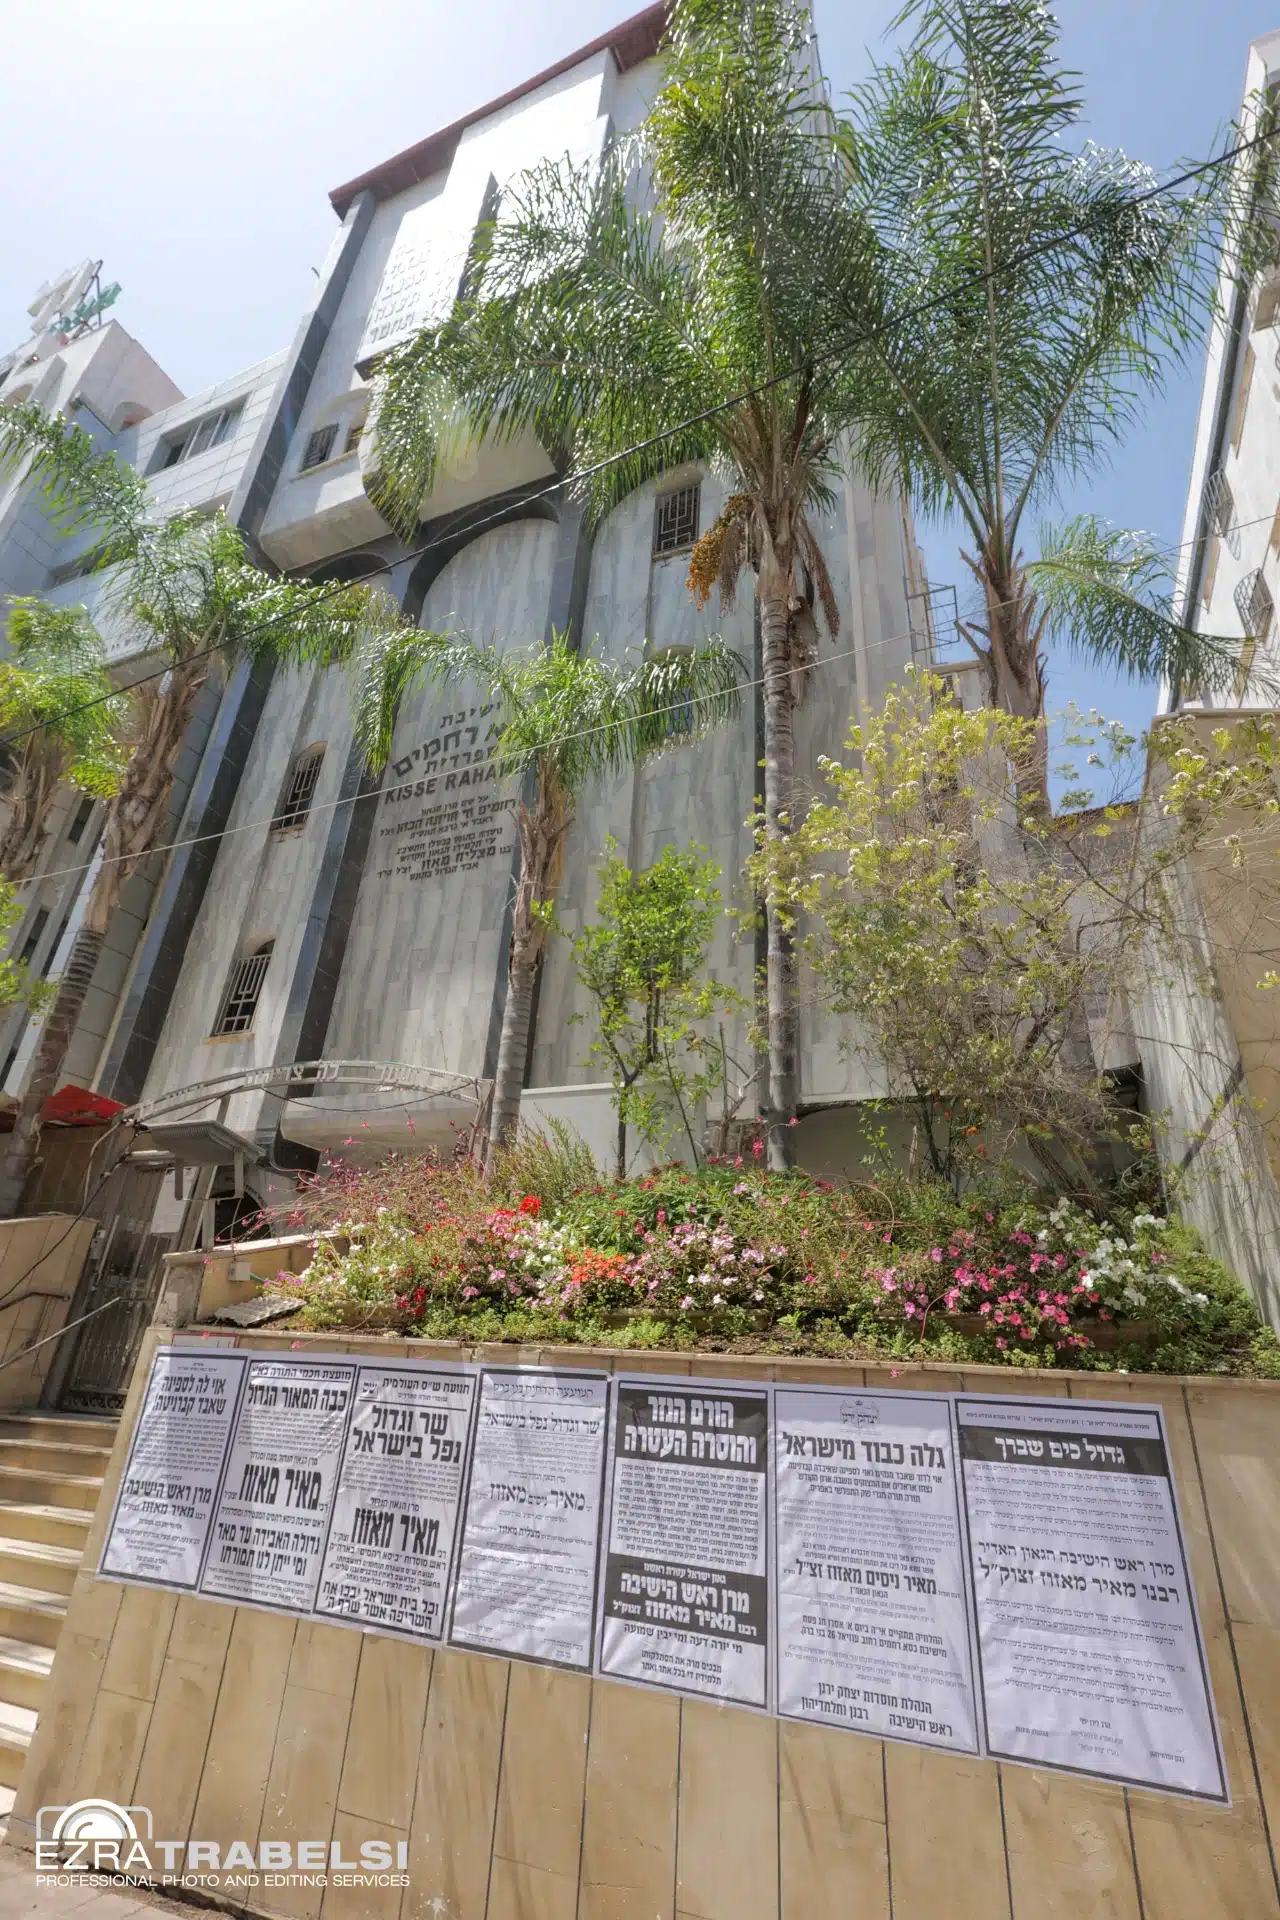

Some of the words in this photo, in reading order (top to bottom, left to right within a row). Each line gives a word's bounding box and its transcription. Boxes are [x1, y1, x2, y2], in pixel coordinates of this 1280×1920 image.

[392, 725, 479, 778] רחמים
[385, 777, 438, 804] KISSE
[270, 1367, 297, 1377] התורה
[298, 1368, 320, 1378] חכמי
[321, 1370, 351, 1380] מועצת
[161, 1374, 195, 1392] לספינה
[195, 1374, 210, 1393] לה
[211, 1378, 226, 1394] אוי
[382, 1377, 419, 1389] העולמית
[443, 1382, 469, 1394] תנועת
[247, 1382, 278, 1406] הגדול
[281, 1386, 319, 1409] המאור
[320, 1389, 347, 1412] כבה
[197, 1397, 226, 1415] שאבד
[647, 1395, 685, 1424] הנזר
[690, 1399, 733, 1428] הורם
[371, 1404, 413, 1432] וגדול
[419, 1411, 448, 1435] שר
[484, 1406, 525, 1428] בישראל
[529, 1410, 548, 1430] נפל
[550, 1411, 579, 1432] וגדול
[581, 1419, 599, 1434] שר
[352, 1426, 423, 1458] בישראל
[429, 1435, 461, 1463] נפל
[624, 1424, 687, 1457] העטרה
[691, 1430, 756, 1464] והוסרה
[782, 1431, 855, 1460] מישראל
[994, 1436, 1043, 1460] שברך
[1048, 1440, 1081, 1459] כים
[860, 1440, 904, 1465] כבוד
[909, 1442, 945, 1469] גלה
[1082, 1437, 1125, 1464] גדול
[126, 1479, 165, 1499] הישיבה
[165, 1483, 191, 1501] ראש
[238, 1463, 279, 1505] מאזוז
[284, 1468, 321, 1510] מאיר
[490, 1482, 526, 1503] מאזוז
[191, 1486, 211, 1505] מרן
[550, 1489, 585, 1510] מאיר
[141, 1500, 168, 1515] מאזוז
[171, 1504, 194, 1518] מאיר
[407, 1502, 419, 1512] מרן
[218, 1522, 236, 1541] מאד
[239, 1525, 252, 1544] עד
[350, 1507, 394, 1548] מאזוז
[400, 1514, 439, 1556] מאיר
[252, 1527, 290, 1549] האבידה
[291, 1532, 320, 1554] גדולה
[219, 1545, 255, 1567] תמורתו
[978, 1541, 1016, 1556] האדיר
[1020, 1546, 1055, 1562] הגאון
[255, 1549, 270, 1569] לנו
[270, 1553, 290, 1576] ייתן
[292, 1556, 307, 1576] ומי
[403, 1555, 427, 1567] מוסדות
[429, 1560, 446, 1570] ראש
[1059, 1551, 1110, 1567] הישיבה
[1113, 1557, 1145, 1572] ראש
[686, 1567, 710, 1581] ישראל
[826, 1564, 862, 1584] מאזוז
[1148, 1561, 1174, 1578] מרן
[322, 1581, 338, 1595] את
[620, 1572, 677, 1606] הישיבה
[865, 1570, 899, 1589] ניסים
[903, 1575, 936, 1595] מאיר
[1039, 1571, 1086, 1591] מאזוז
[1091, 1577, 1136, 1598] מאיר
[340, 1584, 360, 1599] יבכו
[364, 1588, 397, 1606] ישראל
[679, 1582, 717, 1613] ראש
[1141, 1584, 1179, 1603] רבנו
[336, 1597, 360, 1613] שרף
[363, 1602, 387, 1619] אשר
[399, 1596, 417, 1611] בית
[421, 1598, 438, 1616] וכל
[644, 1599, 690, 1623] מאזוז
[720, 1588, 749, 1616] מרן
[389, 1608, 432, 1629] השריפה
[694, 1608, 735, 1632] מאיר
[624, 1623, 654, 1636] שמועה
[656, 1629, 672, 1639] יבין
[673, 1632, 687, 1643] ומי
[827, 1629, 835, 1639] 26
[689, 1635, 708, 1647] דעה
[710, 1639, 729, 1650] יורה
[732, 1643, 742, 1654] מי
[641, 1649, 673, 1663] הסתלקותו
[674, 1656, 684, 1665] את
[686, 1658, 699, 1668] מרה
[670, 1666, 685, 1678] בכל
[701, 1661, 721, 1673] מבכים
[818, 1682, 834, 1695] ירנן
[837, 1685, 860, 1700] יצחק
[863, 1690, 897, 1708] מוסדות
[900, 1697, 932, 1714] הנהלת
[849, 1705, 868, 1720] רבנן
[888, 1713, 925, 1731] הישיבה
[928, 1721, 952, 1737] ראש
